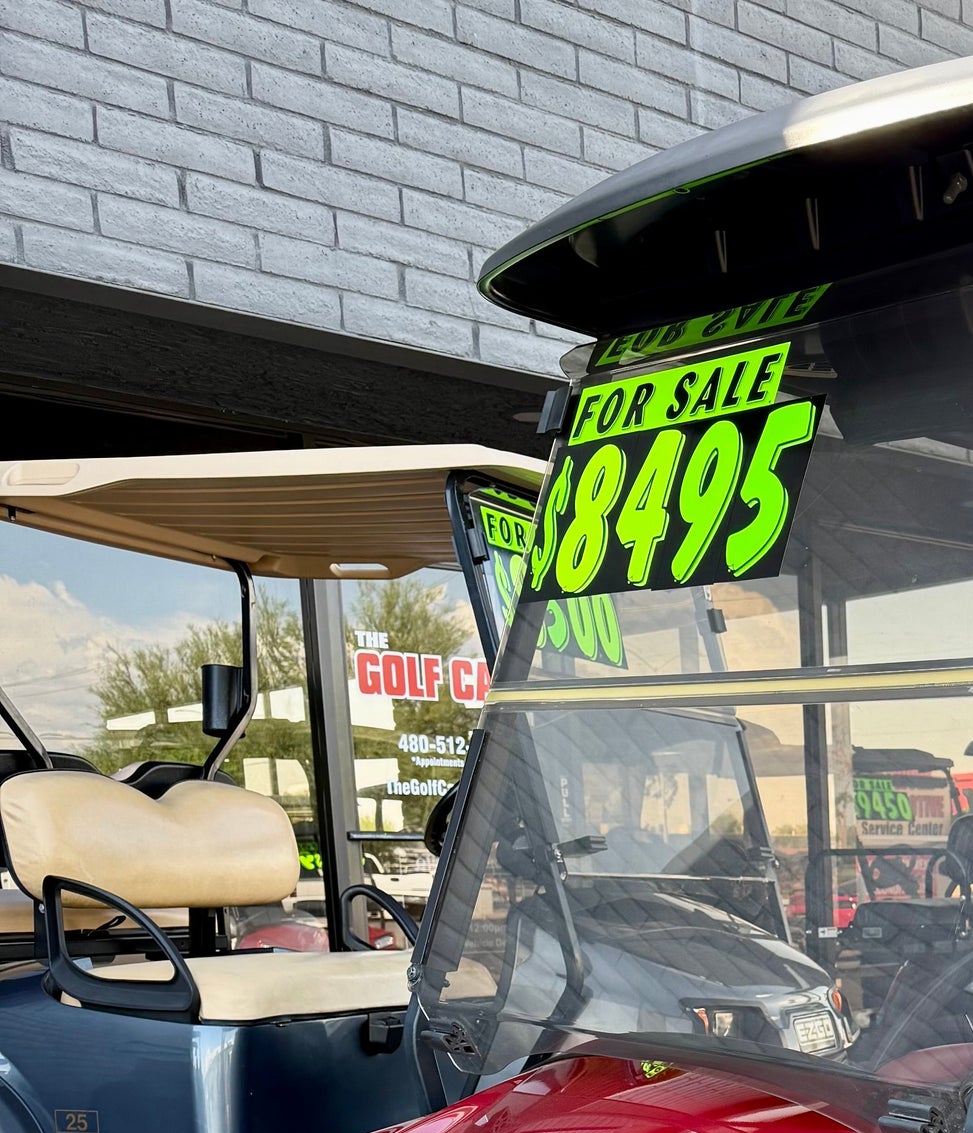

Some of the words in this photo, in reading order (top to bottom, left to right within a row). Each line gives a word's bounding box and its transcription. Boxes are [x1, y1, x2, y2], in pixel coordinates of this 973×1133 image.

[572, 382, 656, 440] FOR
[665, 351, 784, 421] SALE
[530, 401, 816, 594] $8495
[486, 512, 527, 549] FOR
[354, 631, 389, 649] THE
[355, 650, 442, 700] GOLF
[861, 821, 903, 836] Service
[908, 821, 944, 836] Center
[65, 1113, 88, 1131] 25
